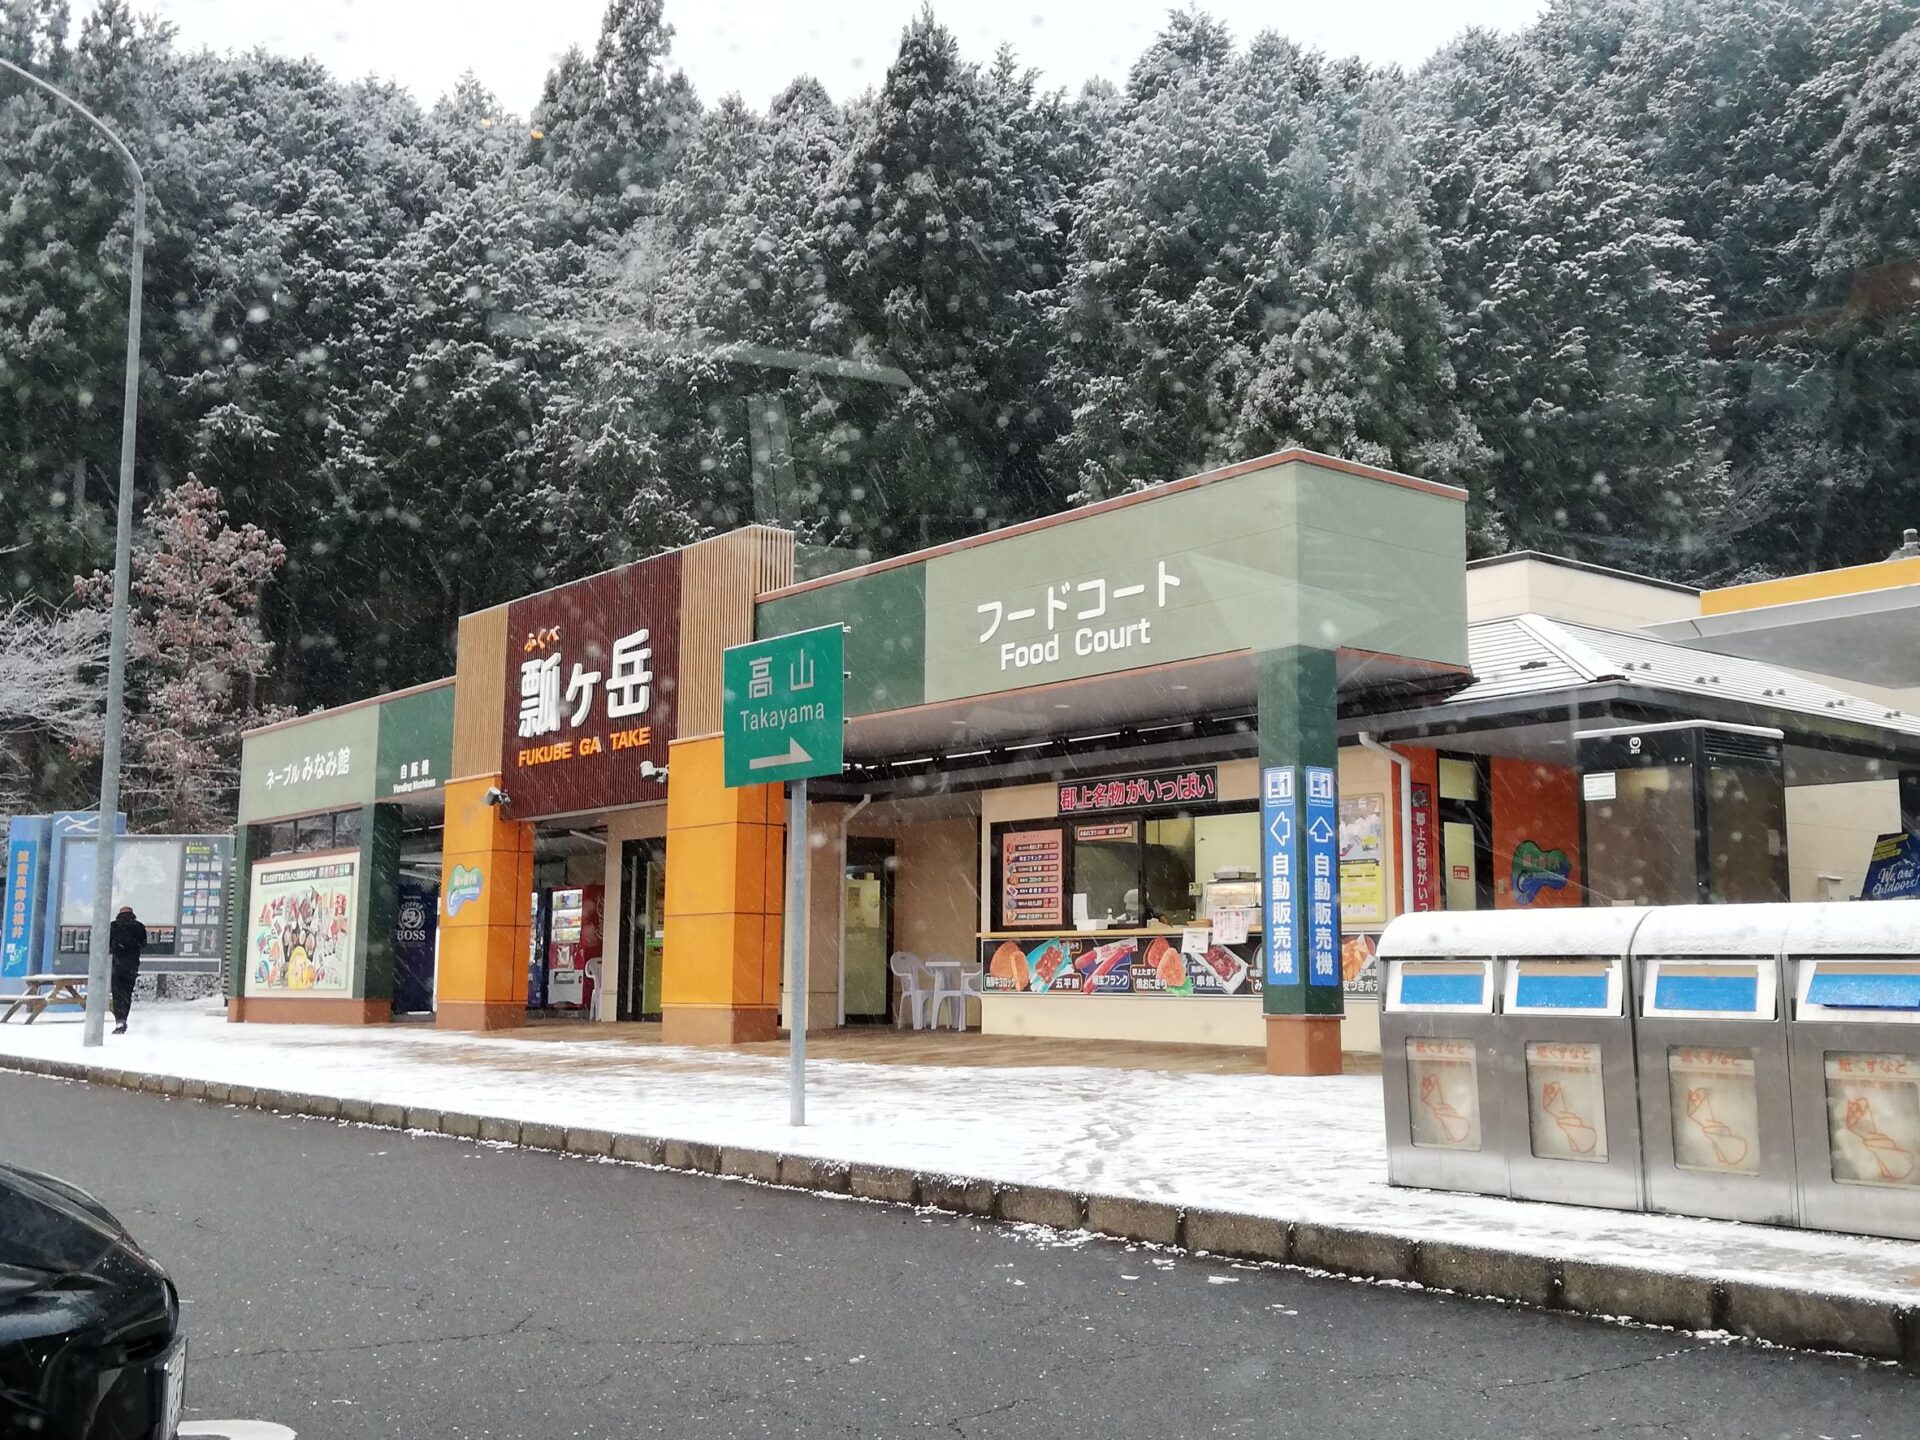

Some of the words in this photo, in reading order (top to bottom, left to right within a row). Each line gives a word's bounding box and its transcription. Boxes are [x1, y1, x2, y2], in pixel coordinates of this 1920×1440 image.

[977, 561, 1181, 643] フードコート
[524, 625, 560, 652] ふくべ
[1000, 634, 1059, 671] Food
[1075, 618, 1151, 656] Court
[749, 648, 814, 699] 高山
[740, 702, 825, 732] Takayama
[519, 741, 573, 767] FUKUBE
[579, 736, 602, 756] GA
[609, 726, 651, 751] TAKE
[1060, 772, 1214, 812] 郡上名物がいっぱい
[1878, 867, 1897, 884] We
[1897, 868, 1915, 880] are
[1272, 852, 1293, 975] 自動販売機
[1314, 852, 1334, 976] 自動販売機
[397, 930, 426, 941] BOSS
[1055, 978, 1080, 989] 五平餅
